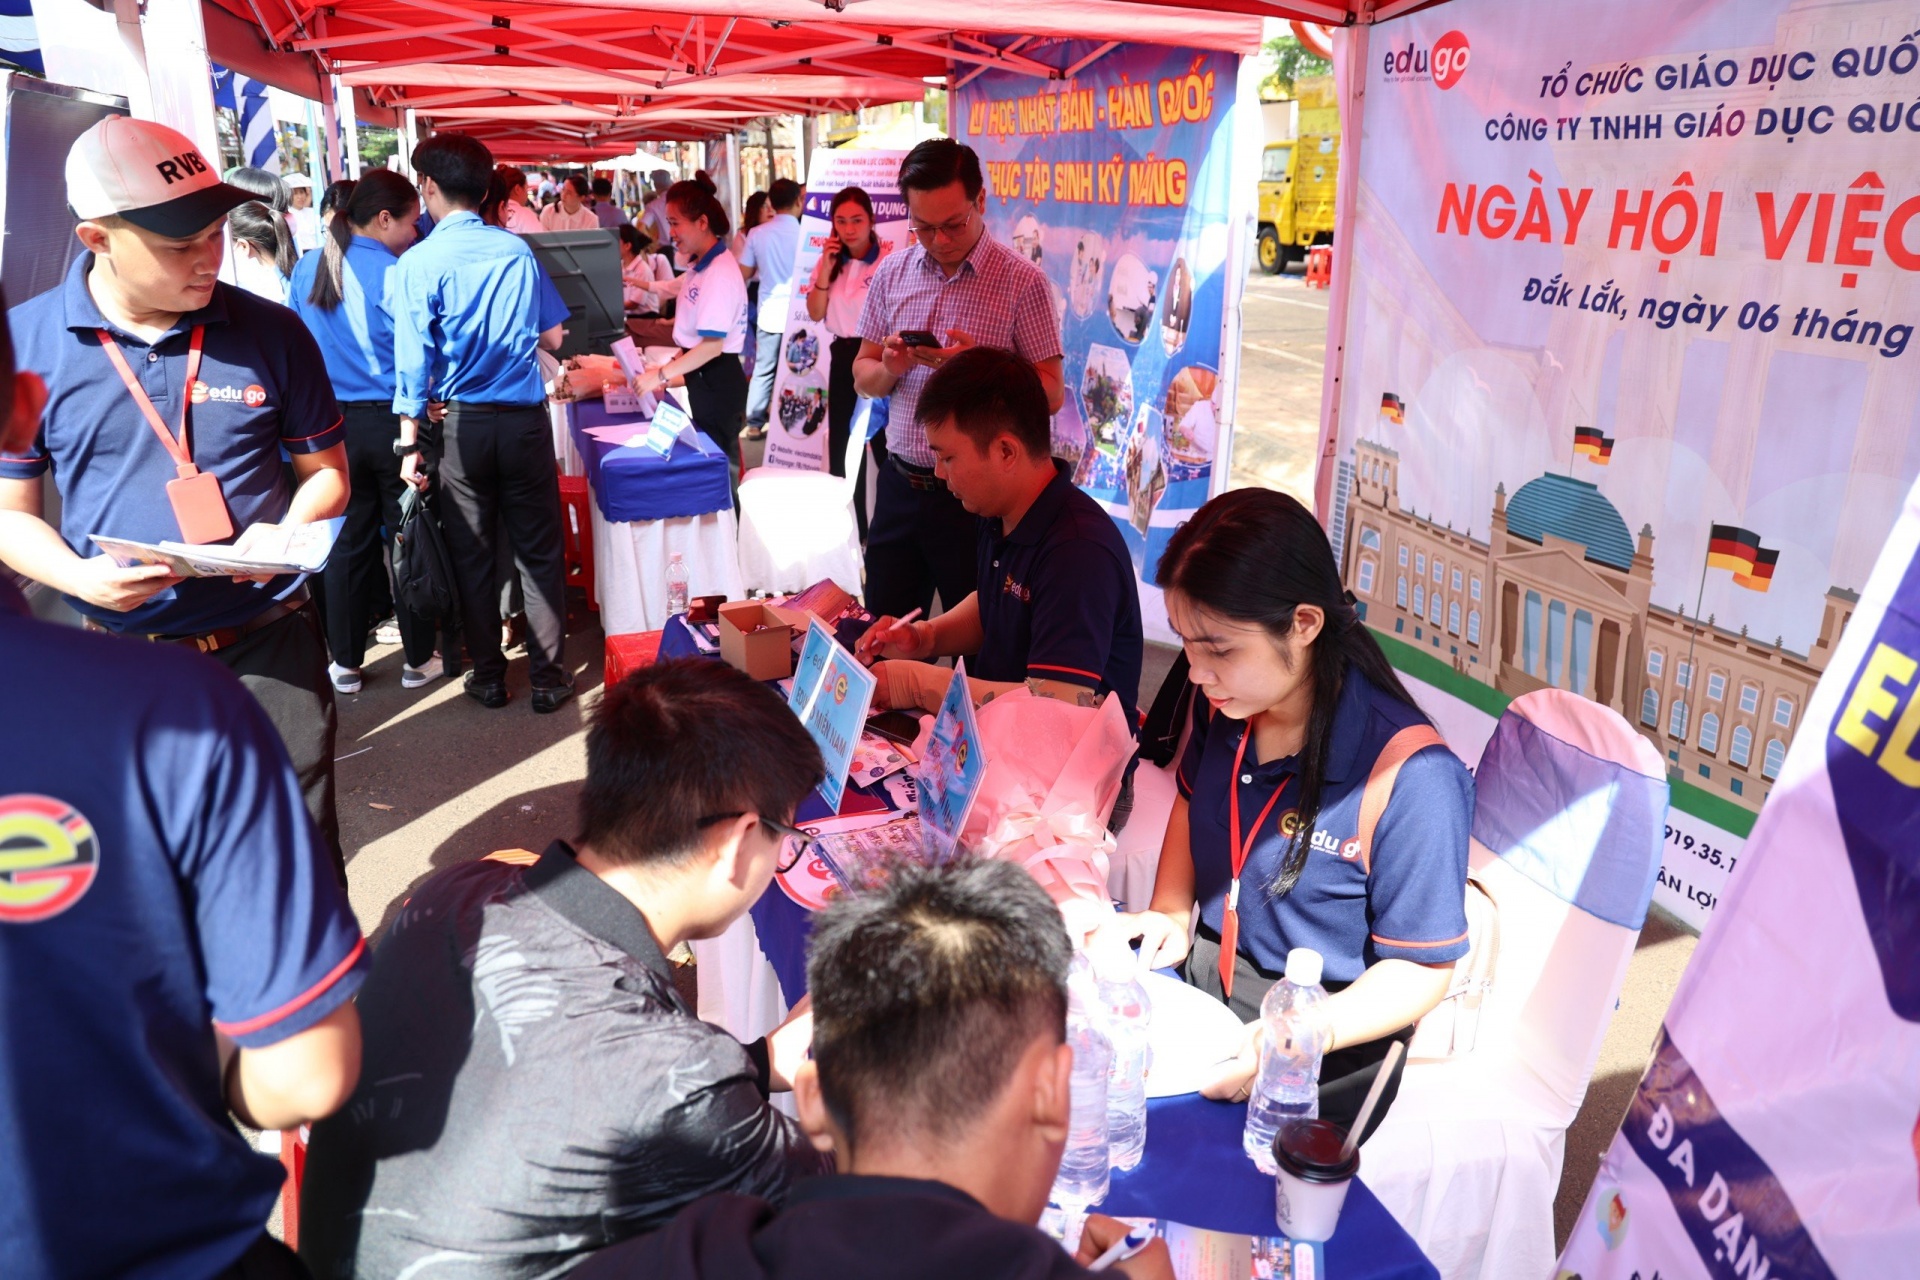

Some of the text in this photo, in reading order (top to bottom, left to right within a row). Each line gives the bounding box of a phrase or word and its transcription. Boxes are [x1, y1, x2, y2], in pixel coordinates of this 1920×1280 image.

[986, 98, 1016, 143] HỌC
[1017, 86, 1057, 141] NHẬT
[1059, 78, 1094, 132] BẢN
[1108, 73, 1154, 130] HÀN
[1157, 54, 1214, 126] QUỐC
[1540, 61, 1573, 98] TỔ
[1575, 62, 1644, 97] CHỨC
[1655, 54, 1739, 91] GIÁO
[1748, 51, 1816, 91] DỤC
[1485, 112, 1548, 141] CÔNG
[1556, 117, 1582, 141] TY
[1590, 114, 1662, 140] TNHH
[1674, 103, 1745, 138] GIÁO
[1754, 105, 1835, 143] DỤC
[156, 151, 207, 185] RVB
[1024, 154, 1051, 207] TẬP
[1054, 161, 1093, 204] SINH
[1097, 152, 1125, 206] KỸ
[1128, 152, 1188, 208] NĂNG
[878, 201, 907, 219] DỤNG
[1436, 168, 1594, 245] NGÀY
[1607, 171, 1724, 273] HỘI
[1523, 273, 1914, 358] Đắk Lắk, ngày 06 tháng
[209, 385, 243, 401] edu
[1646, 1102, 1695, 1188] ĐA
[1697, 1170, 1786, 1280] DẠN
